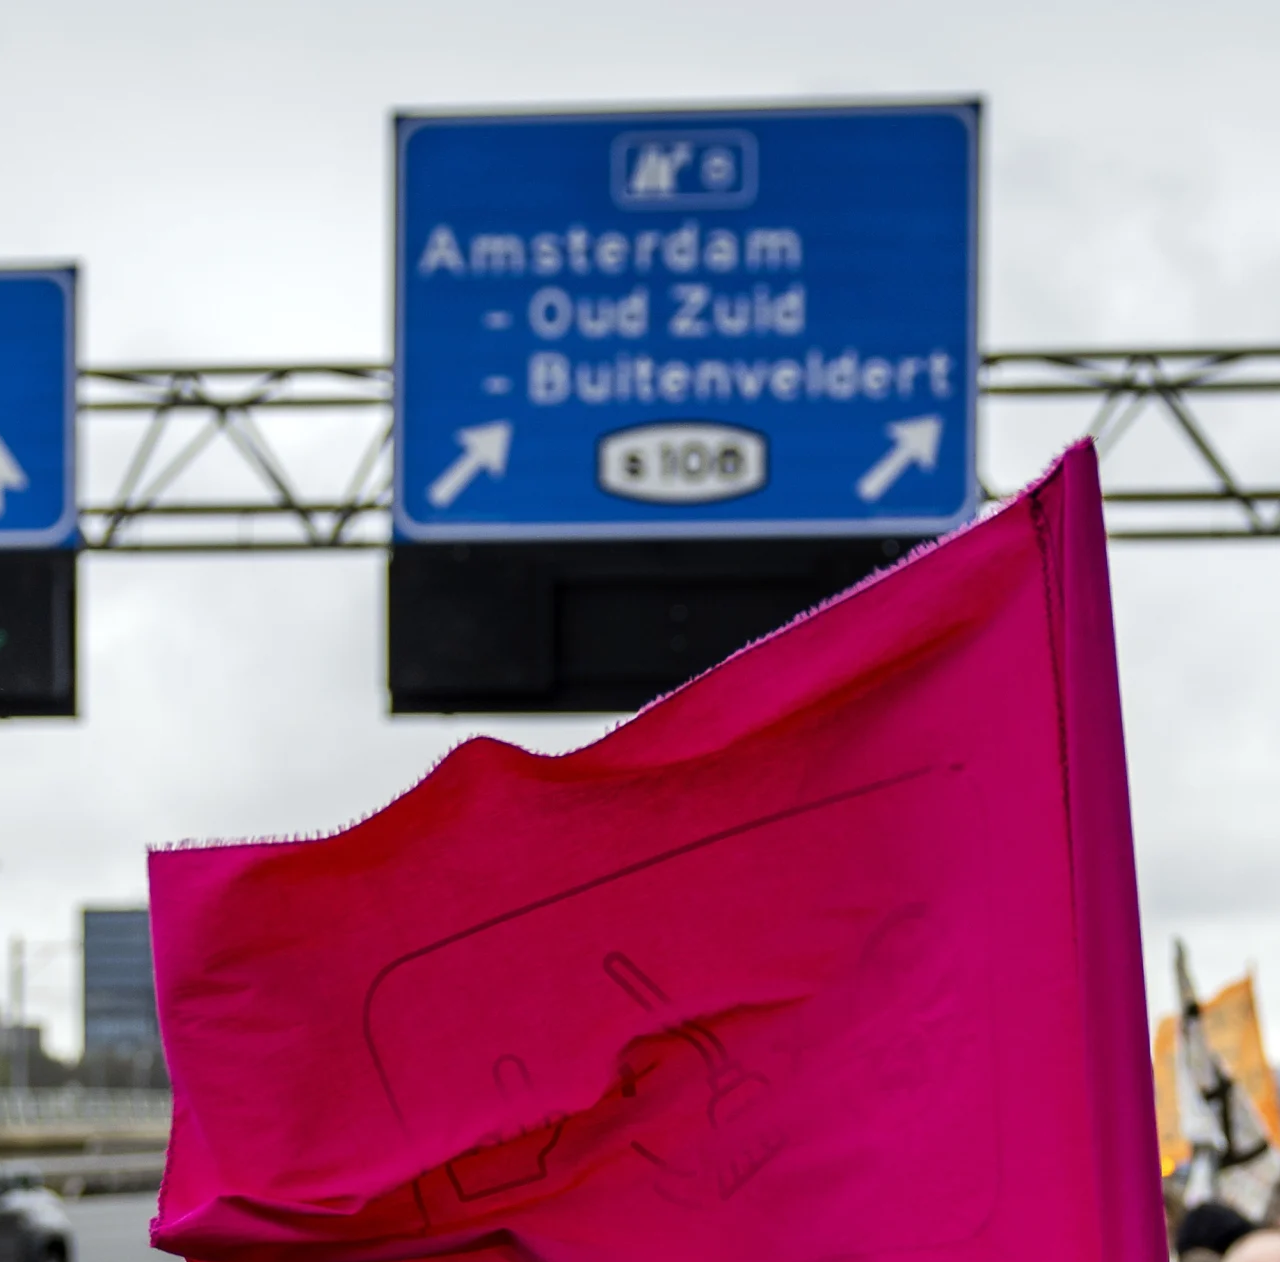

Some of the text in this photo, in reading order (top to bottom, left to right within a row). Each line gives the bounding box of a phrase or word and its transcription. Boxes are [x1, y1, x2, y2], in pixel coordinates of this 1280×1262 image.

[420, 221, 801, 275] Amsterdam
[529, 286, 649, 339] Oud
[671, 283, 805, 338] Zuid
[529, 349, 953, 404] Buitenveldert
